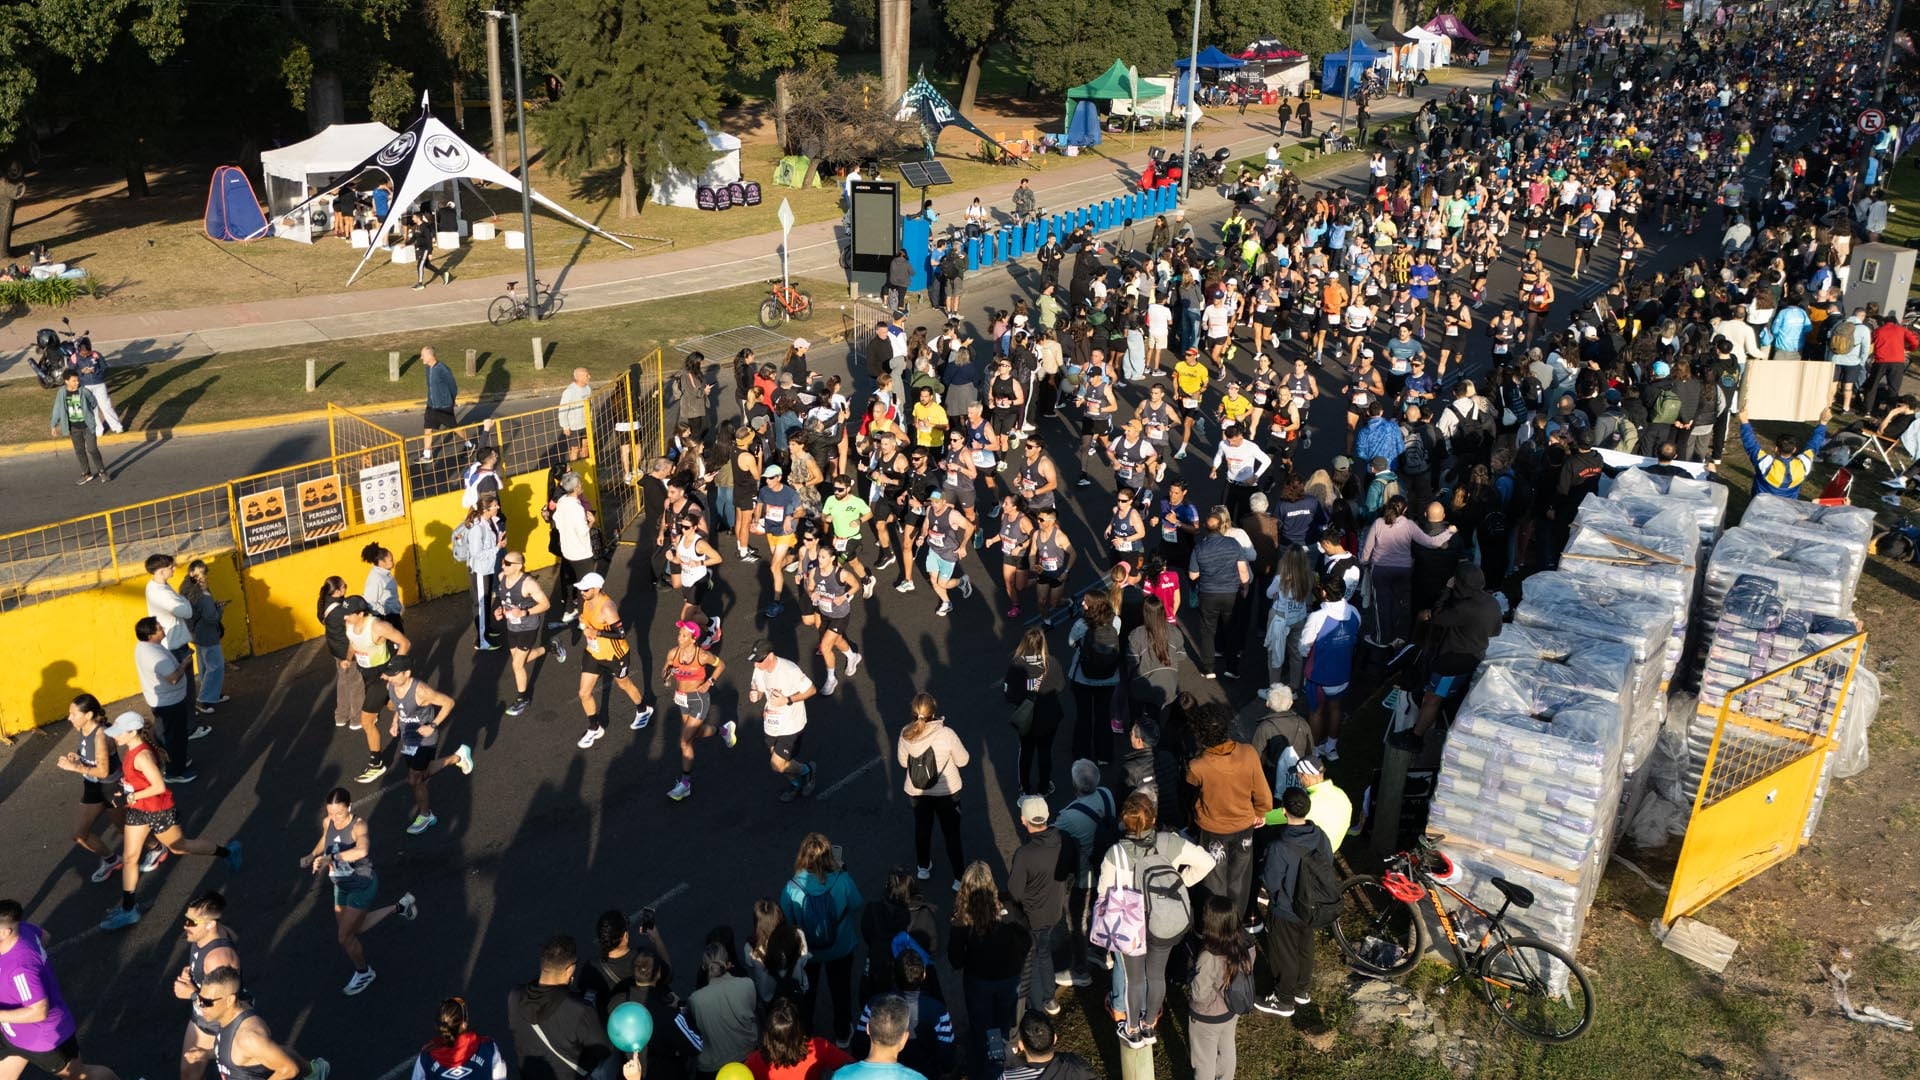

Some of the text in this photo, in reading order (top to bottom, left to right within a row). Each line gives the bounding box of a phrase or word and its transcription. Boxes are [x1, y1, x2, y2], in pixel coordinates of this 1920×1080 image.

[1864, 114, 1878, 129] E
[433, 144, 460, 158] M
[308, 507, 338, 520] PERSONAS
[306, 513, 342, 529] TRABAJANDO
[251, 522, 283, 535] PERSONAS
[248, 528, 288, 544] TRABAJANDO
